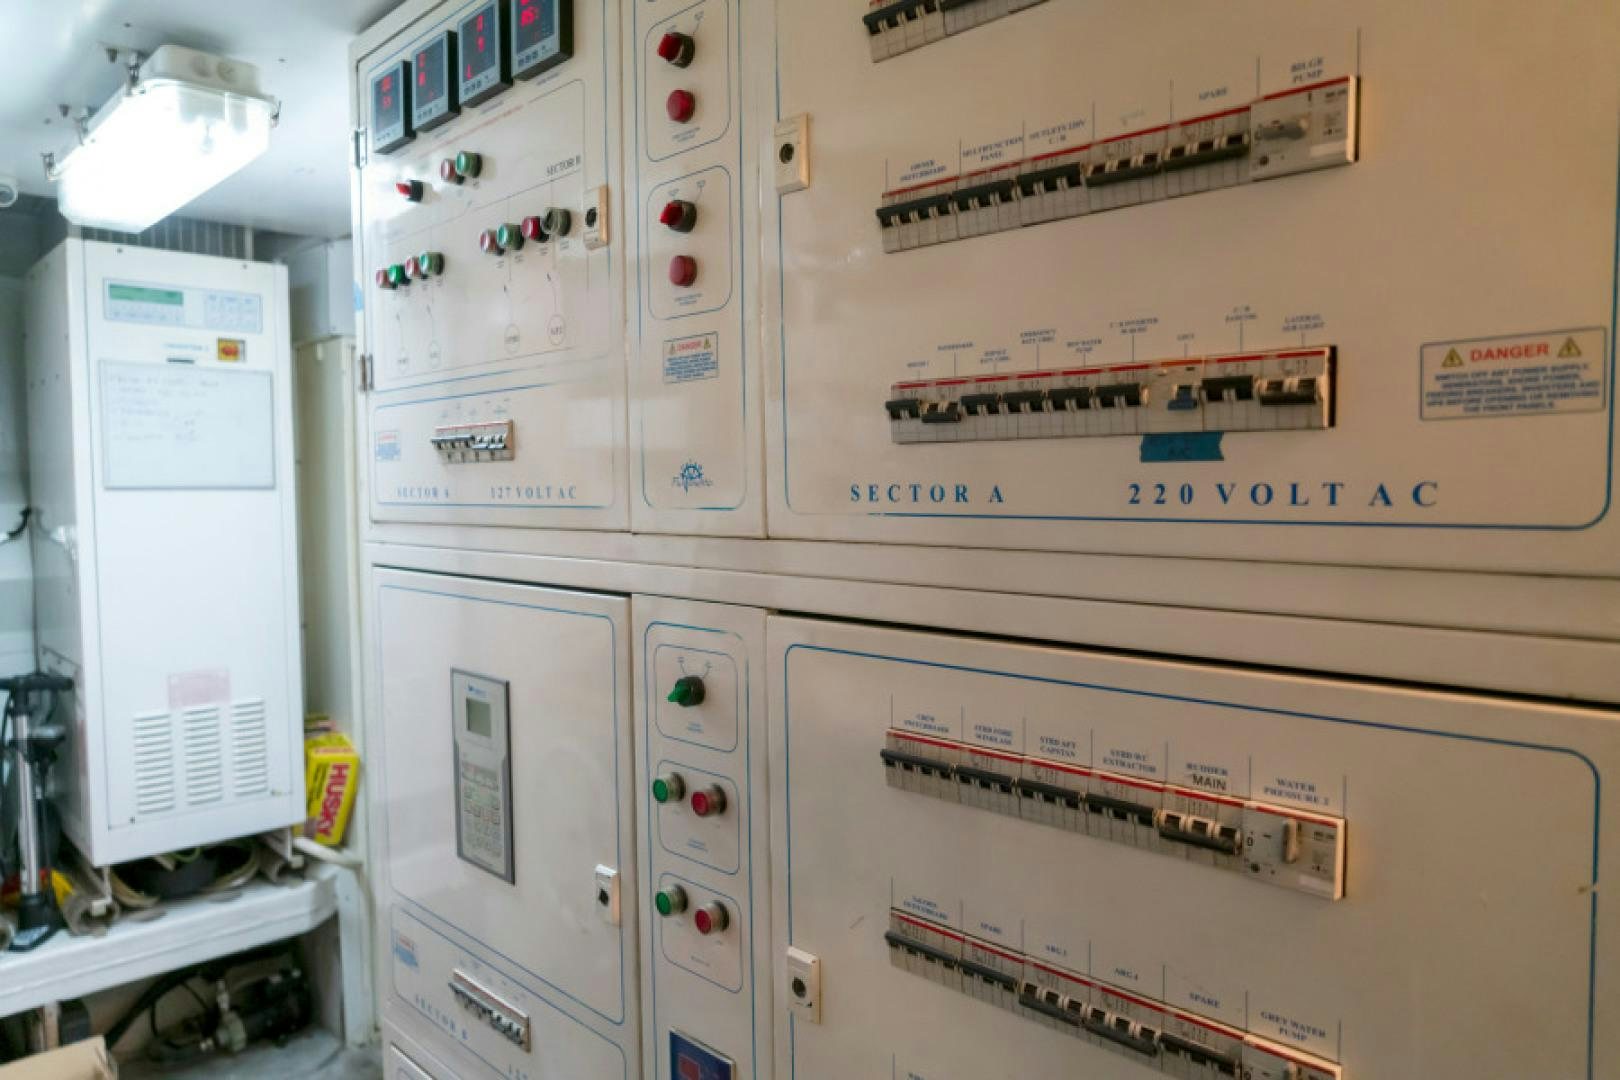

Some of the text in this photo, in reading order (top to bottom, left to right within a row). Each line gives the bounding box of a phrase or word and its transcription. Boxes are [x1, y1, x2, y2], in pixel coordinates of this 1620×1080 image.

[1293, 69, 1323, 83] PUMP
[1470, 342, 1550, 363] DANGER
[1511, 366, 1547, 375] POWER
[516, 487, 552, 500] VOLT
[850, 484, 1004, 503] SECTOR A
[1128, 484, 1193, 505] 220
[1216, 482, 1344, 507] VOLT
[1192, 774, 1227, 791] MAIN
[1276, 777, 1316, 792] WATER
[316, 762, 352, 837] HUSKY
[1190, 992, 1221, 1008] SPARE
[1261, 1011, 1326, 1038] GREY WATER
